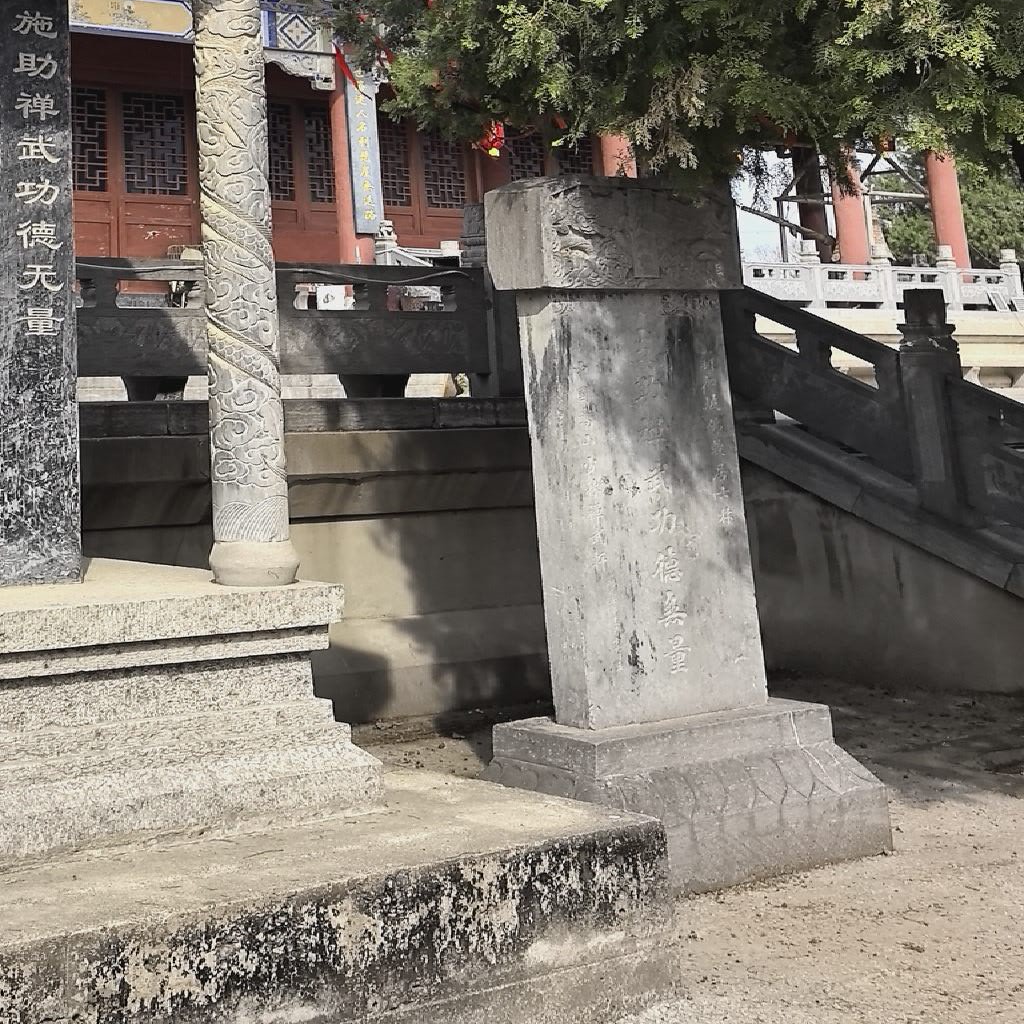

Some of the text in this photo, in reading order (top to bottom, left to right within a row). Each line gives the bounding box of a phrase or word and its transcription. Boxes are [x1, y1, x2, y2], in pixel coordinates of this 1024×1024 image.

[12, 10, 65, 337] 施助禅武功德无量
